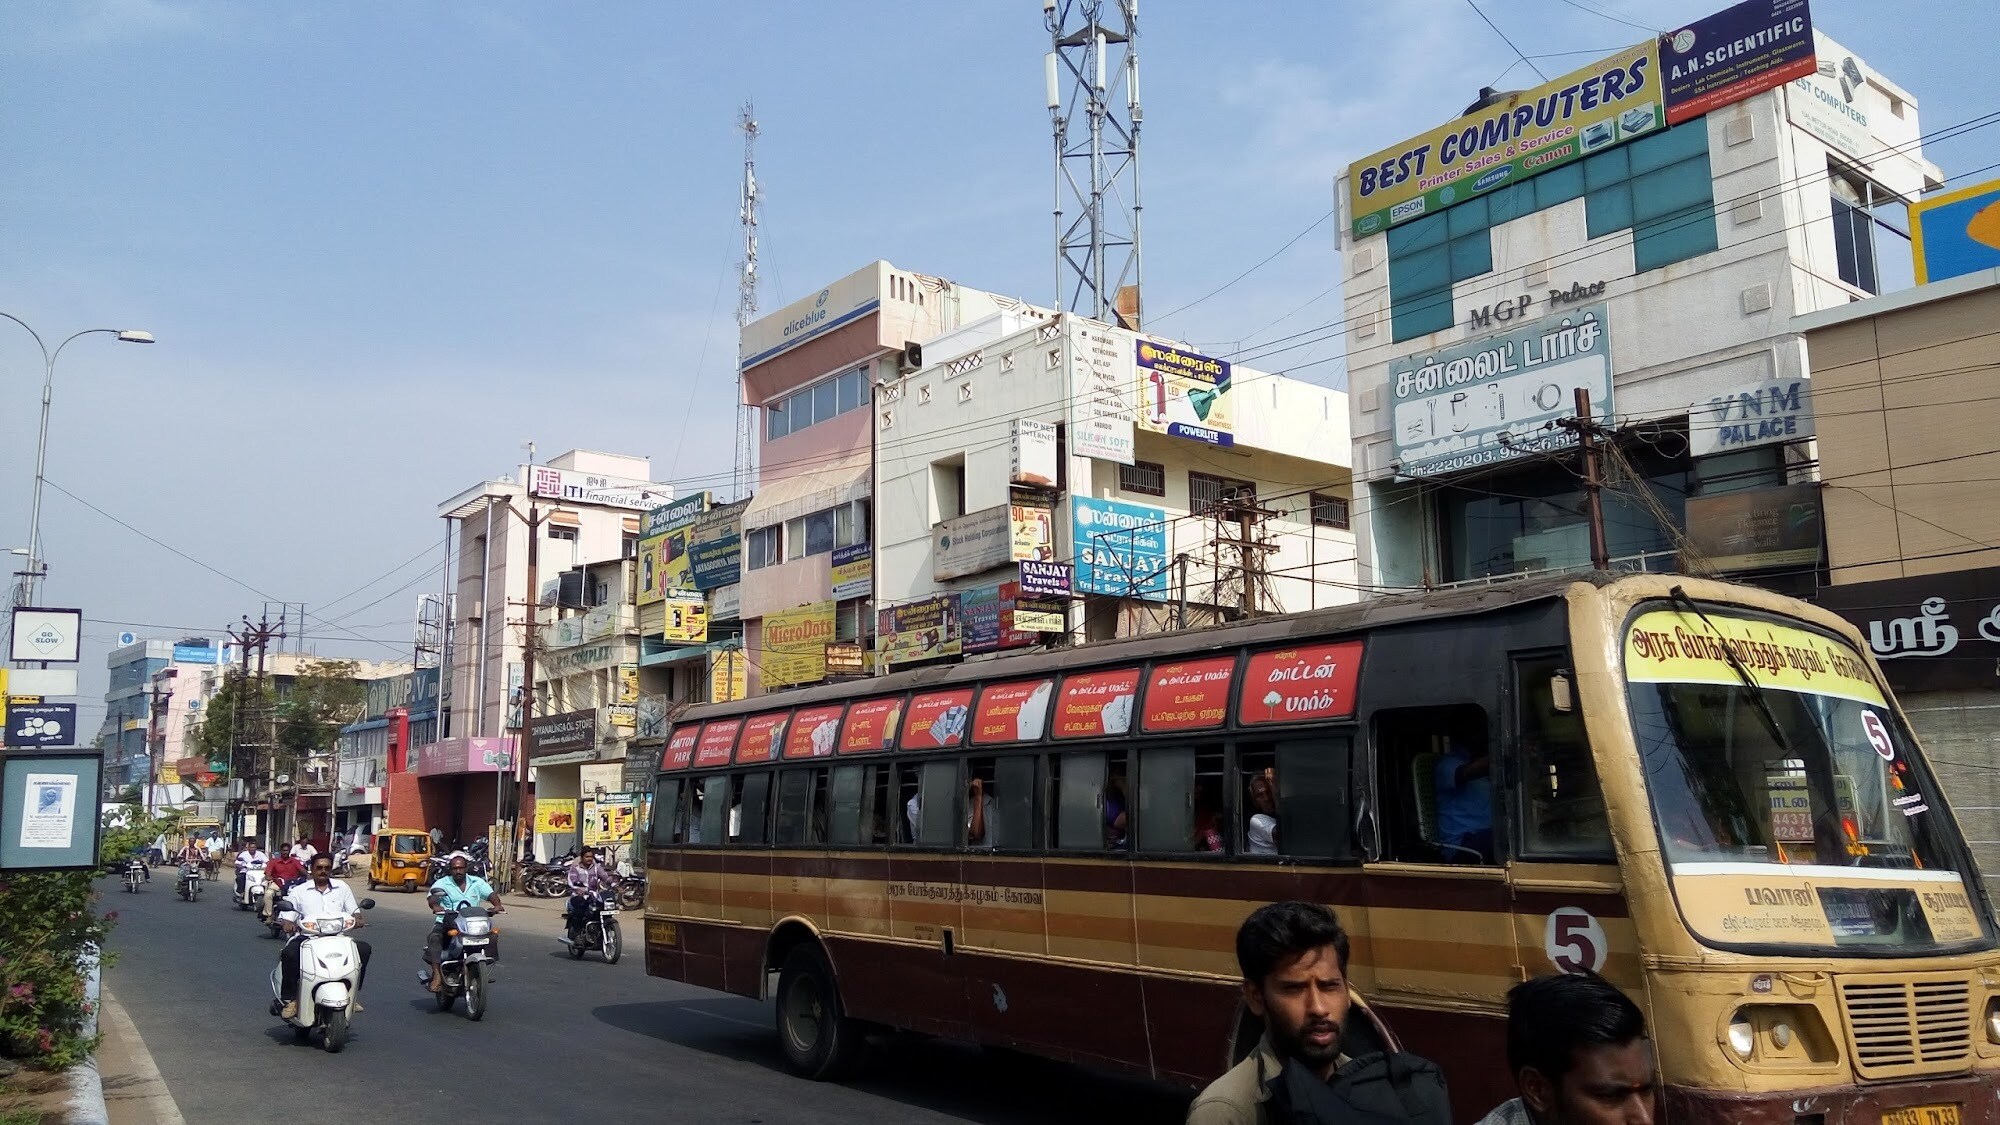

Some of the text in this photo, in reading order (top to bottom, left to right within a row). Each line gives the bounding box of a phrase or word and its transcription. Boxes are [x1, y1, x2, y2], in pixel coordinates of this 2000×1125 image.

[1671, 16, 1804, 80] A.N.SCIENTIFIC
[1814, 87, 1867, 127] COMPUTERS
[1359, 56, 1649, 197] BEST COMPUTERS
[1419, 126, 1574, 190] Printer Sales & Service
[1523, 144, 1573, 168] Canon
[1477, 170, 1509, 187] SAMSUNG
[1392, 199, 1423, 217] EPSON
[1470, 281, 1606, 331] MGP Palace
[783, 308, 826, 337] aliceblue
[1395, 312, 1601, 398] சன்லைட் டார்ச்
[1168, 386, 1180, 397] LED
[1709, 382, 1802, 422] VNM
[1021, 420, 1055, 432] INFO NET
[1021, 429, 1055, 441] INTERNET
[1094, 422, 1112, 430] ANDROID
[1179, 425, 1219, 441] POWERLITE
[1719, 415, 1797, 446] PALACE
[1109, 437, 1130, 448] SOFT
[563, 484, 583, 499] ITI
[585, 490, 667, 510] financial service
[1012, 506, 1024, 522] 90
[1022, 562, 1069, 578] SANJAY
[1081, 547, 1163, 574] SANJAY
[1026, 574, 1060, 587] Travels
[1079, 580, 1100, 591] Train
[1105, 584, 1120, 594] Bus
[1093, 569, 1155, 587] Travels
[973, 613, 998, 624] Travels
[769, 619, 832, 645] MicroDots
[1632, 627, 1678, 663] அரசு
[1268, 655, 1337, 683] காட்டன்
[1174, 692, 1205, 704] உங்கள்
[1285, 688, 1334, 712] பார்க்
[575, 719, 594, 729] STORE
[1864, 715, 1893, 757] 5
[673, 751, 692, 763] PARK
[1744, 881, 1816, 907] பவானி
[1555, 914, 1596, 974] 5
